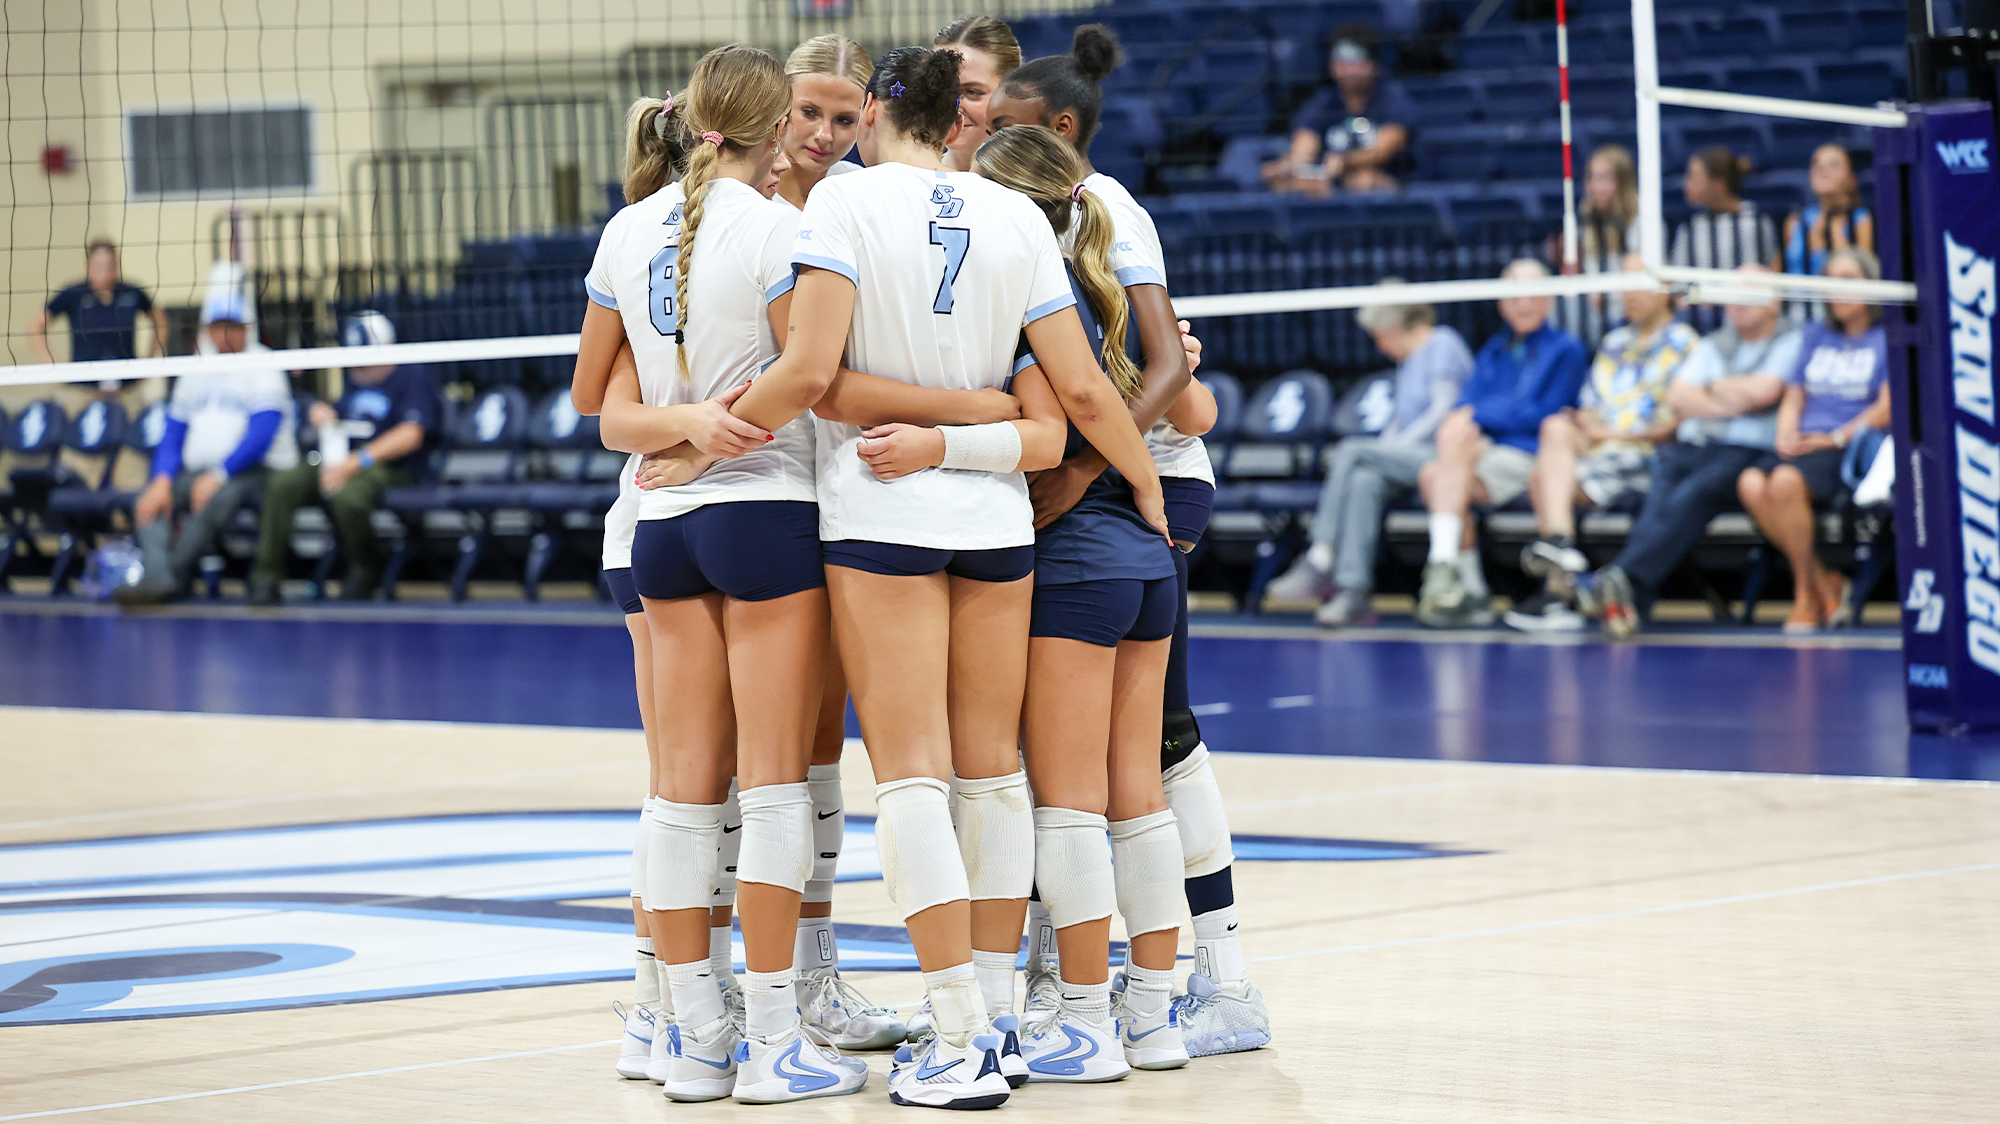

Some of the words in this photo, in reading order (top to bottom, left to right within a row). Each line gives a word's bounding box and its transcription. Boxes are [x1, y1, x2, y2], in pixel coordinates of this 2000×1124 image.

[1935, 139, 1989, 170] WCC
[930, 184, 964, 218] SD
[648, 245, 687, 336] 8
[929, 221, 970, 315] 7
[1943, 229, 1997, 428] SAN
[1955, 420, 2000, 677] DIEGO
[1905, 569, 1945, 634] SD
